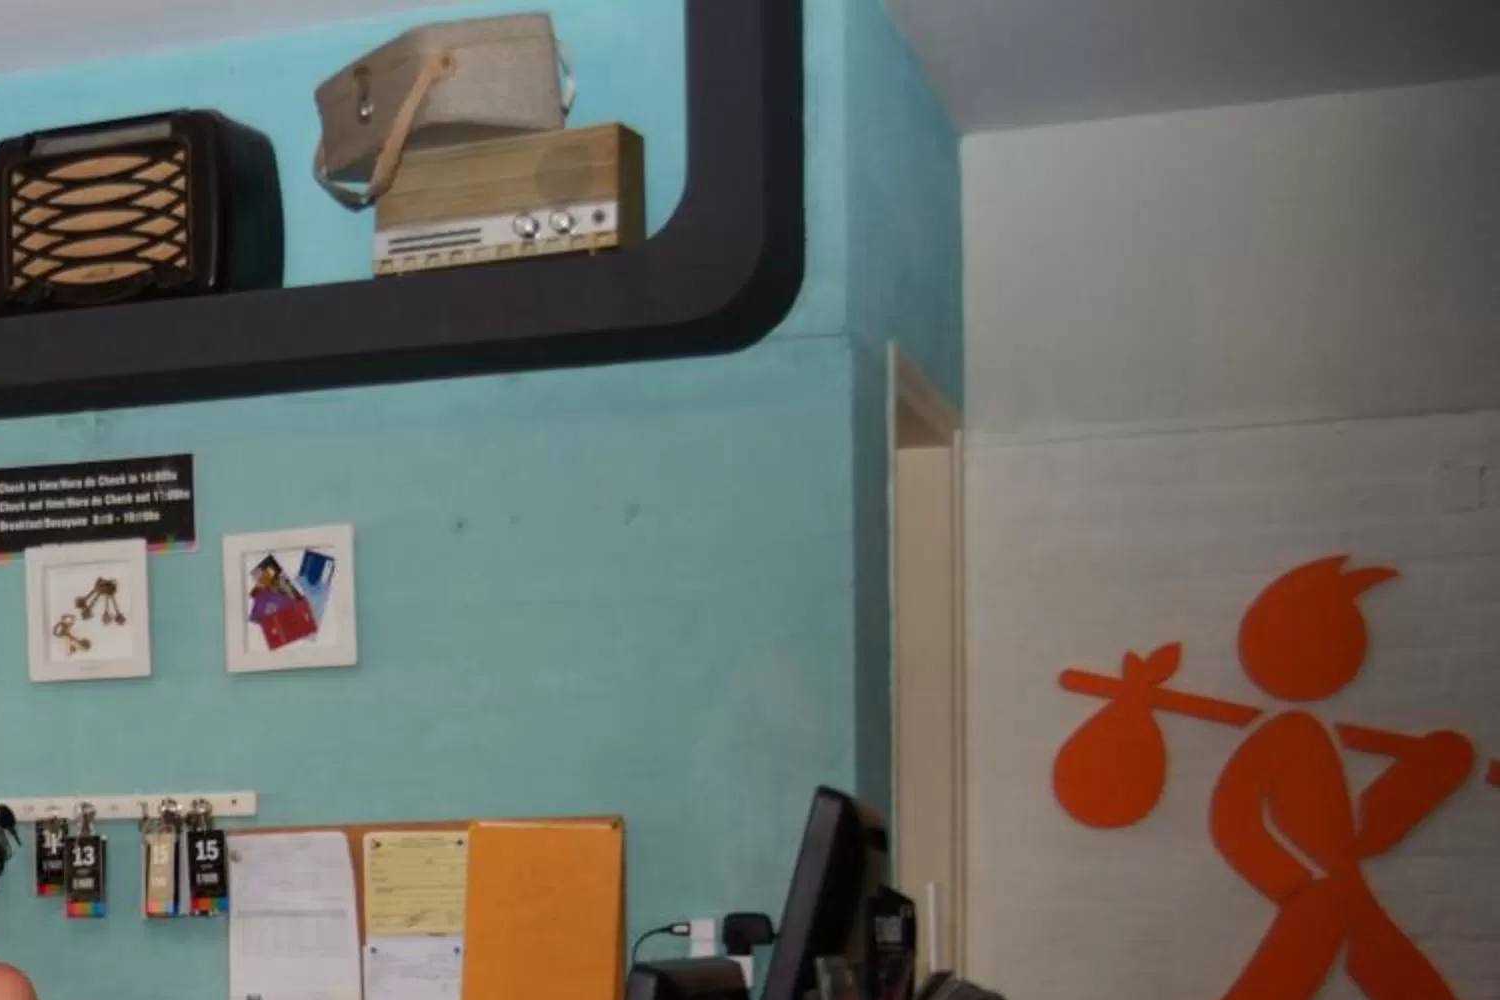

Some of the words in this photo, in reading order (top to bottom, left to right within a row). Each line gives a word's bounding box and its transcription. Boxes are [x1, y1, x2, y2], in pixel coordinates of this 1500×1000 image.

[98, 474, 126, 487] Check
[104, 493, 133, 506] Check
[72, 845, 95, 867] 13
[195, 839, 219, 861] 15
